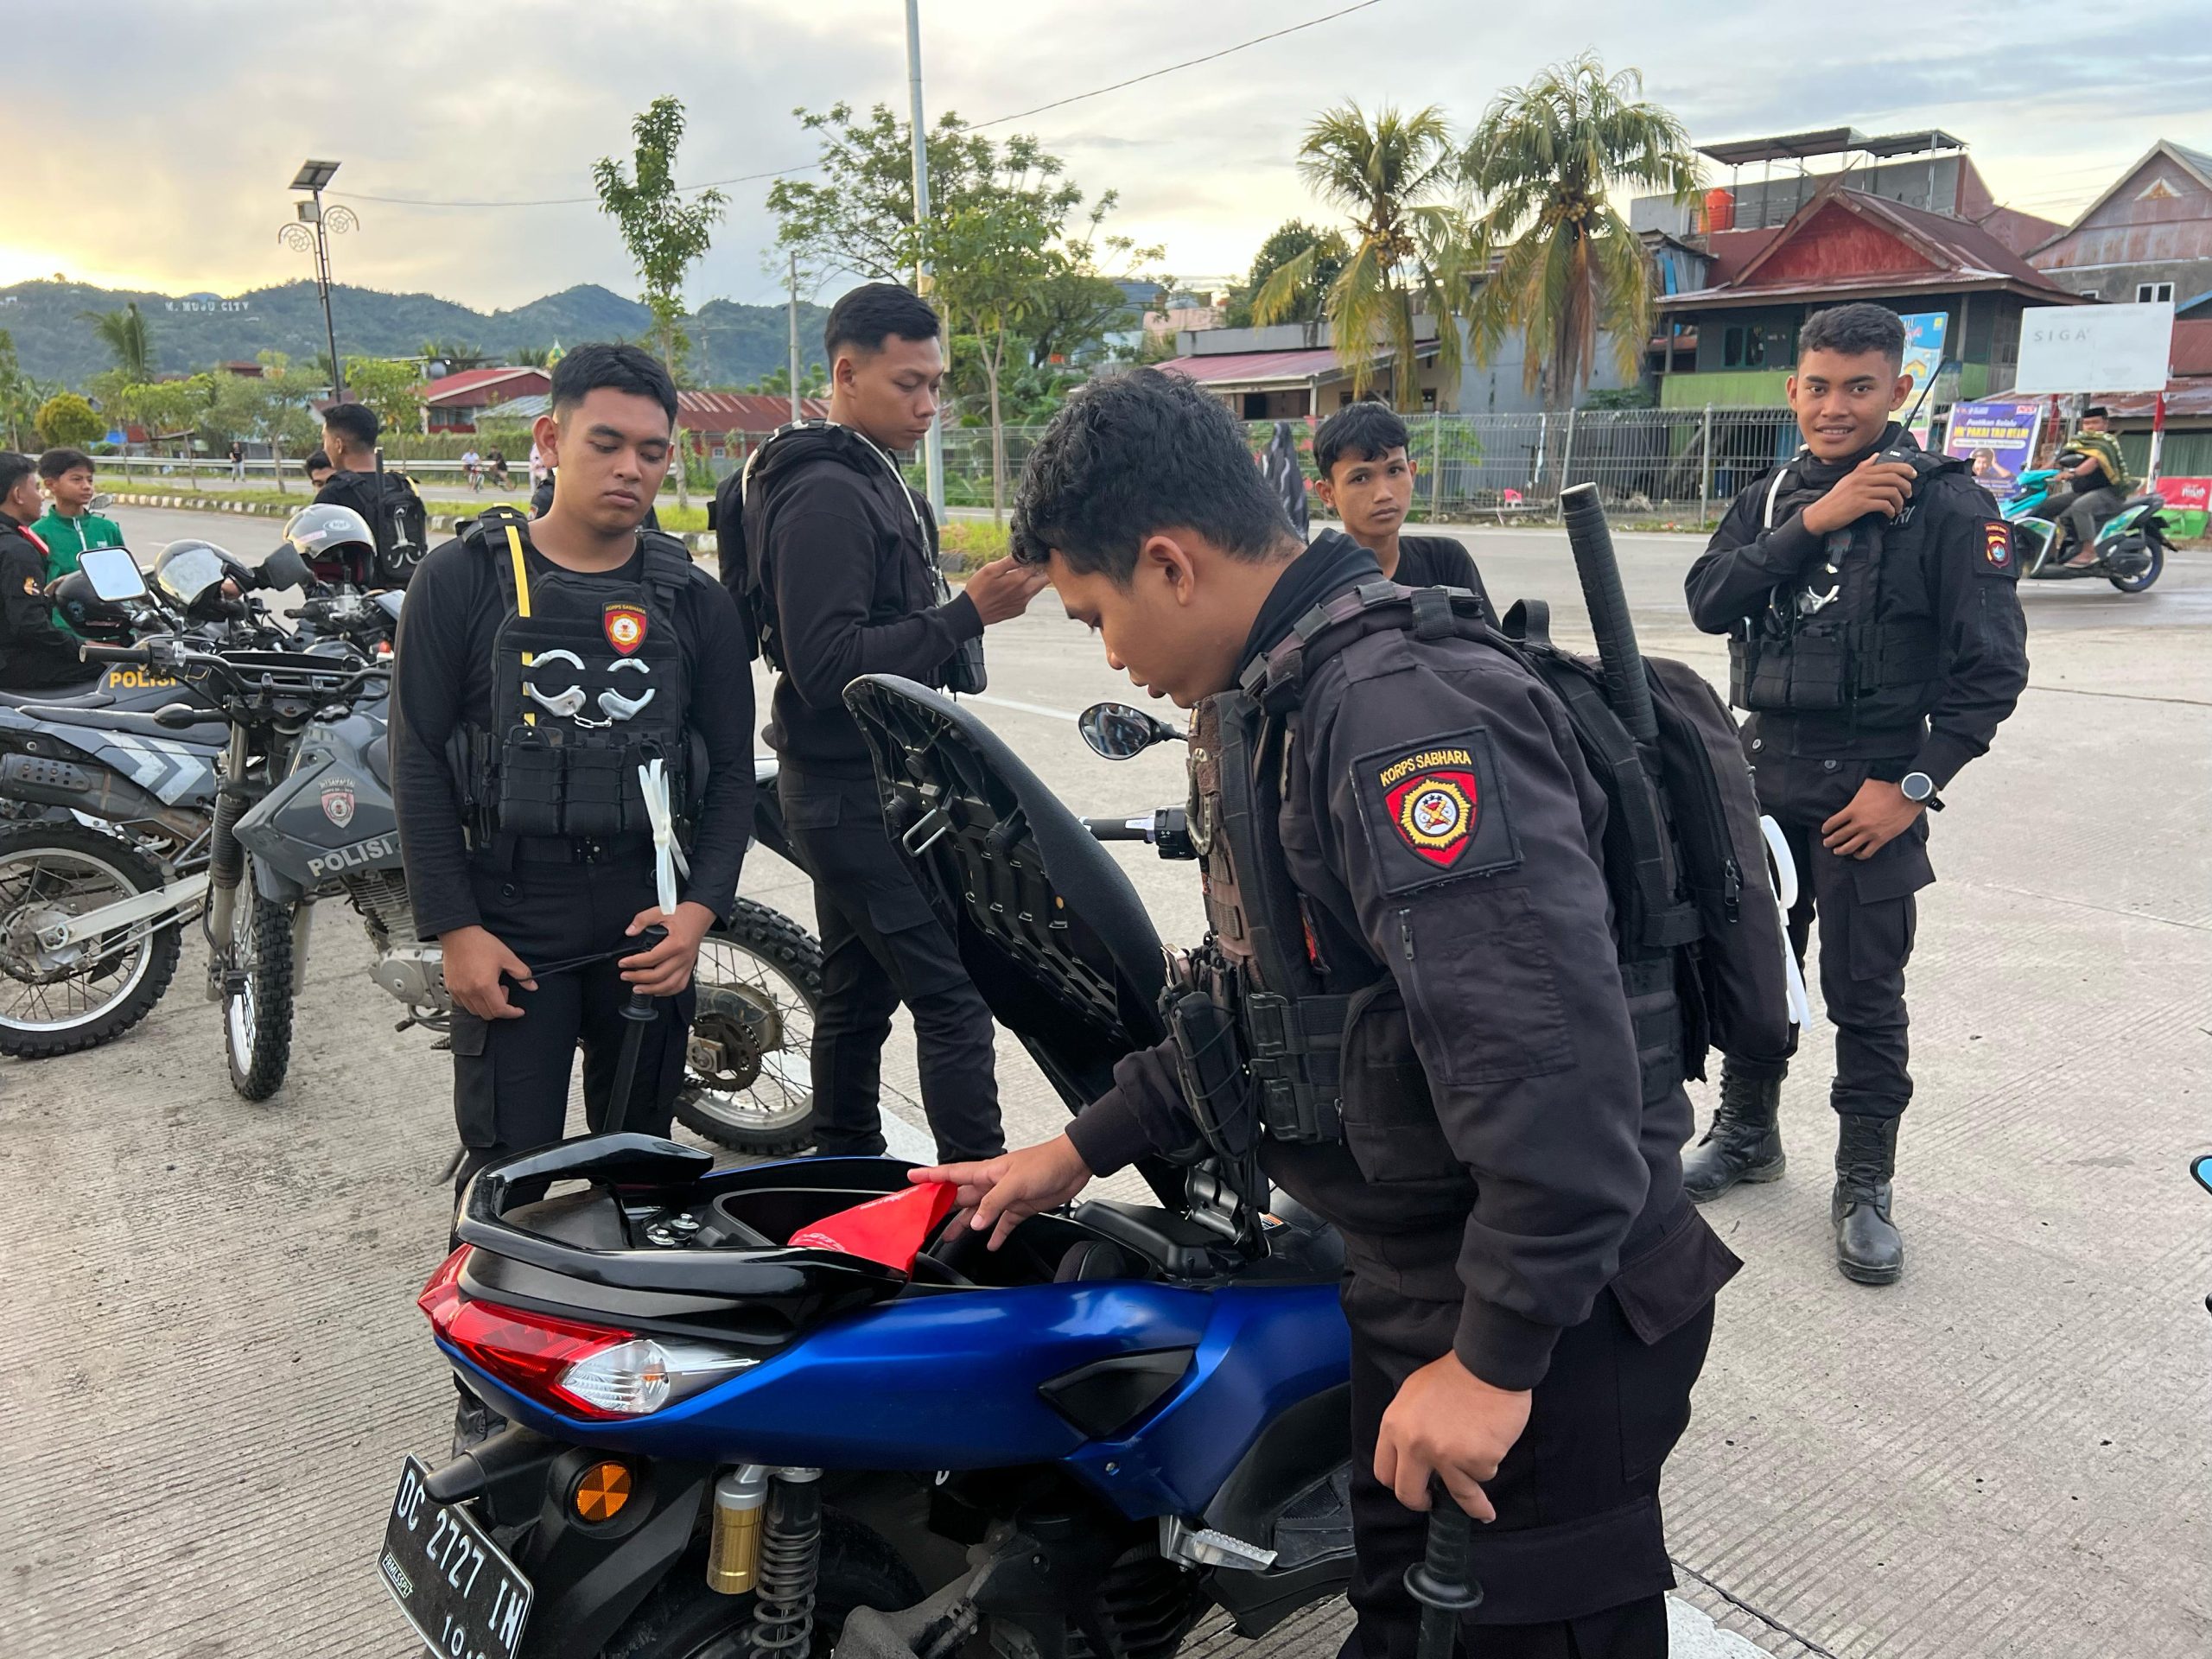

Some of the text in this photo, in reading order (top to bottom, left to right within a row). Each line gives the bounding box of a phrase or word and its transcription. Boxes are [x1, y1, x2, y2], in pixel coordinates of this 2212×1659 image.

[220, 301, 250, 312] CITY
[1380, 749, 1471, 787] KORPS SABHARA
[308, 838, 393, 877] POLISI
[397, 1469, 524, 1650] DC 2727 IN
